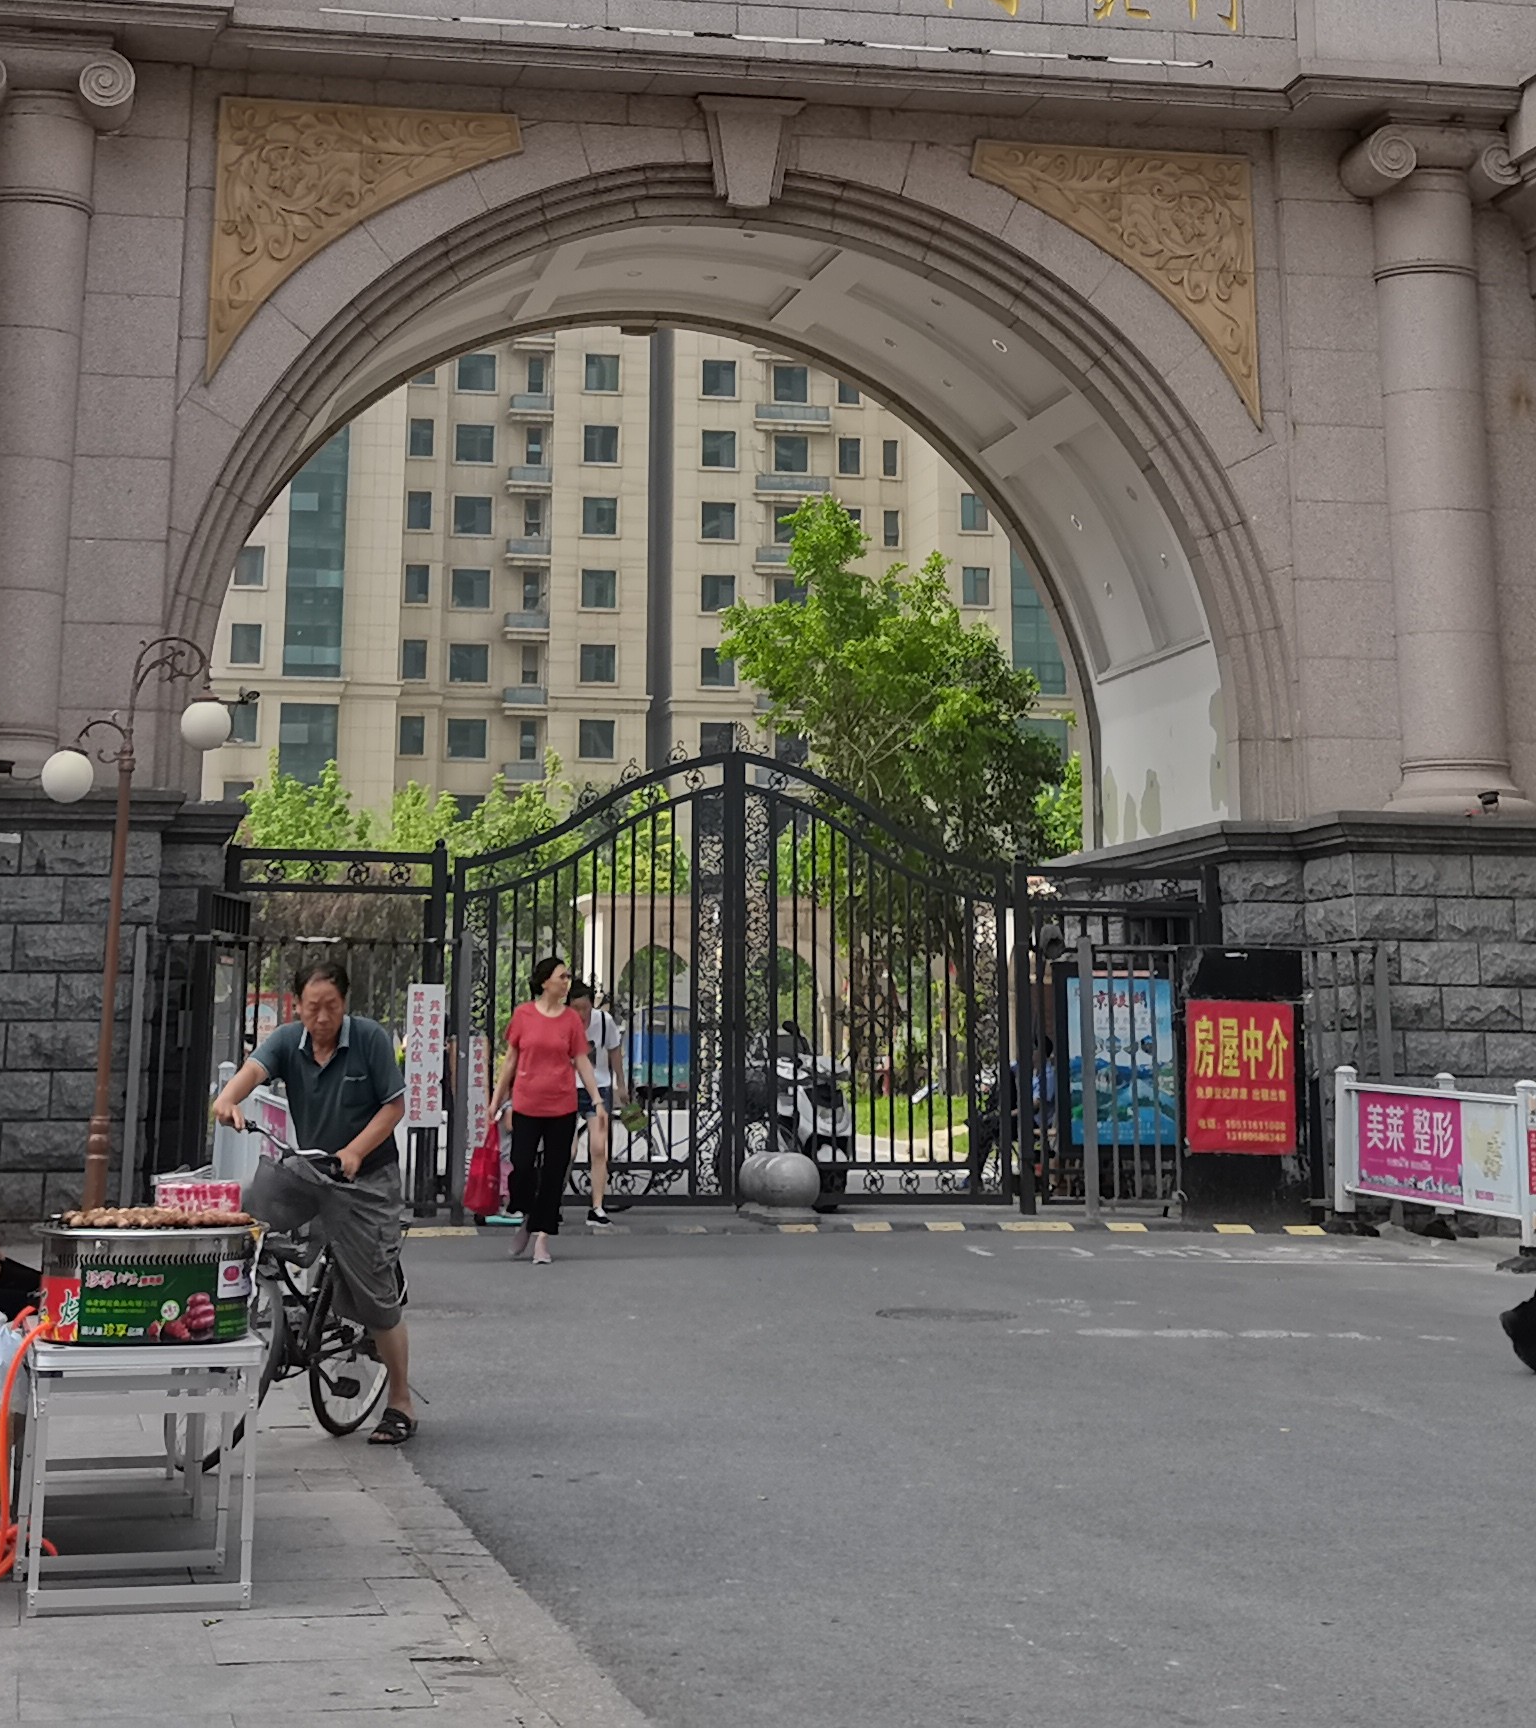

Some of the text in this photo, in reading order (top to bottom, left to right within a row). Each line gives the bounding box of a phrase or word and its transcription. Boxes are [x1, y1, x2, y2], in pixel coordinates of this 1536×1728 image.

[1194, 1015, 1289, 1080] 房屋中介
[1367, 1103, 1454, 1159] 美莱 整形
